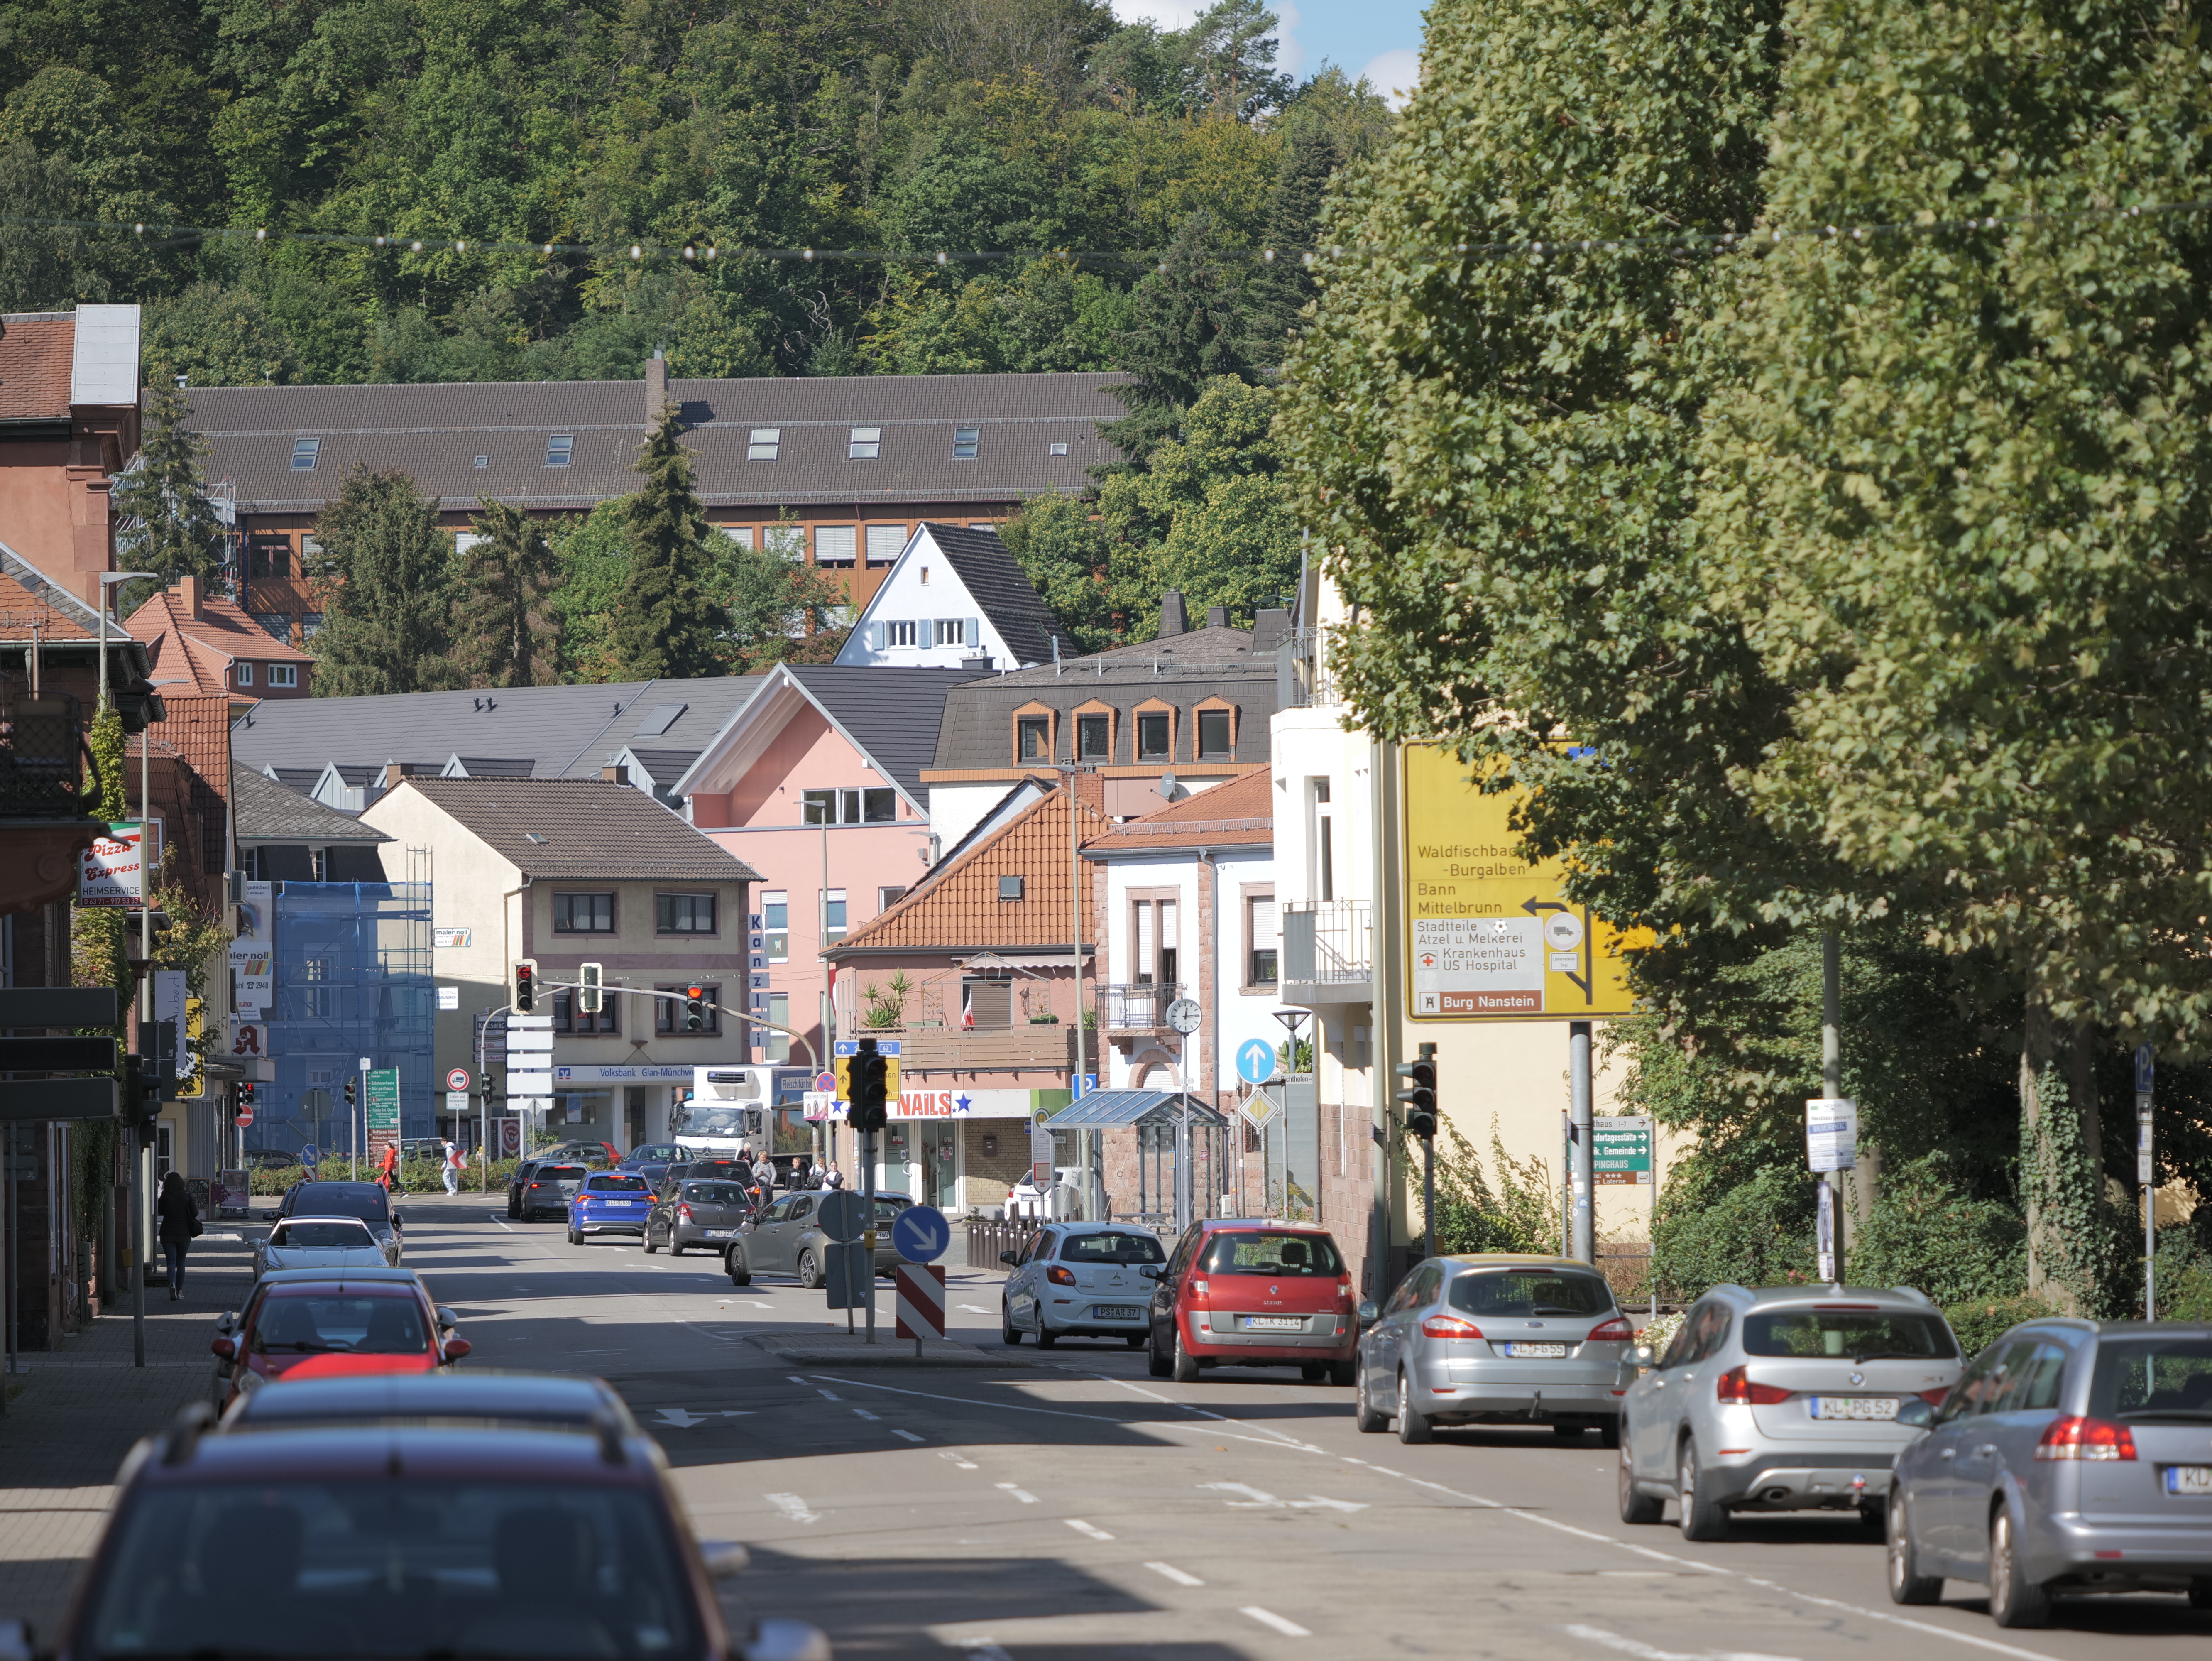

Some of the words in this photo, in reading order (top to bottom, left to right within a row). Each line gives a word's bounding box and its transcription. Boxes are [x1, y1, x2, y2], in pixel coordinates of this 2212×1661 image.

[84, 844, 135, 862] Pizza
[85, 863, 139, 881] Express
[83, 887, 139, 895] HEIMSERVICE
[1418, 883, 1456, 895] Bann
[1419, 901, 1502, 914] Mittelbrunn
[1417, 919, 1477, 932] Stadtteile
[1419, 934, 1450, 945] Atzel
[1456, 936, 1464, 944] u.
[1469, 932, 1522, 944] Melkerei
[250, 951, 269, 960] noll
[1444, 947, 1526, 958] Krankenhaus
[1444, 960, 1460, 971] US
[1466, 959, 1517, 973] Hospital
[1444, 997, 1473, 1010] Burg
[1478, 995, 1534, 1007] Nanstein
[600, 1068, 636, 1077] Volksbank
[782, 1079, 798, 1089] Fleisch
[897, 1093, 951, 1116] NAILS
[1604, 1146, 1637, 1155] Gemeinde
[1253, 1317, 1263, 1325] KL
[1512, 1343, 1526, 1353] KL
[1550, 1343, 1564, 1353] 55
[1825, 1400, 1843, 1413] KL
[1853, 1401, 1871, 1413] PG
[1875, 1401, 1892, 1414] 52
[2186, 1467, 2208, 1486] KL
